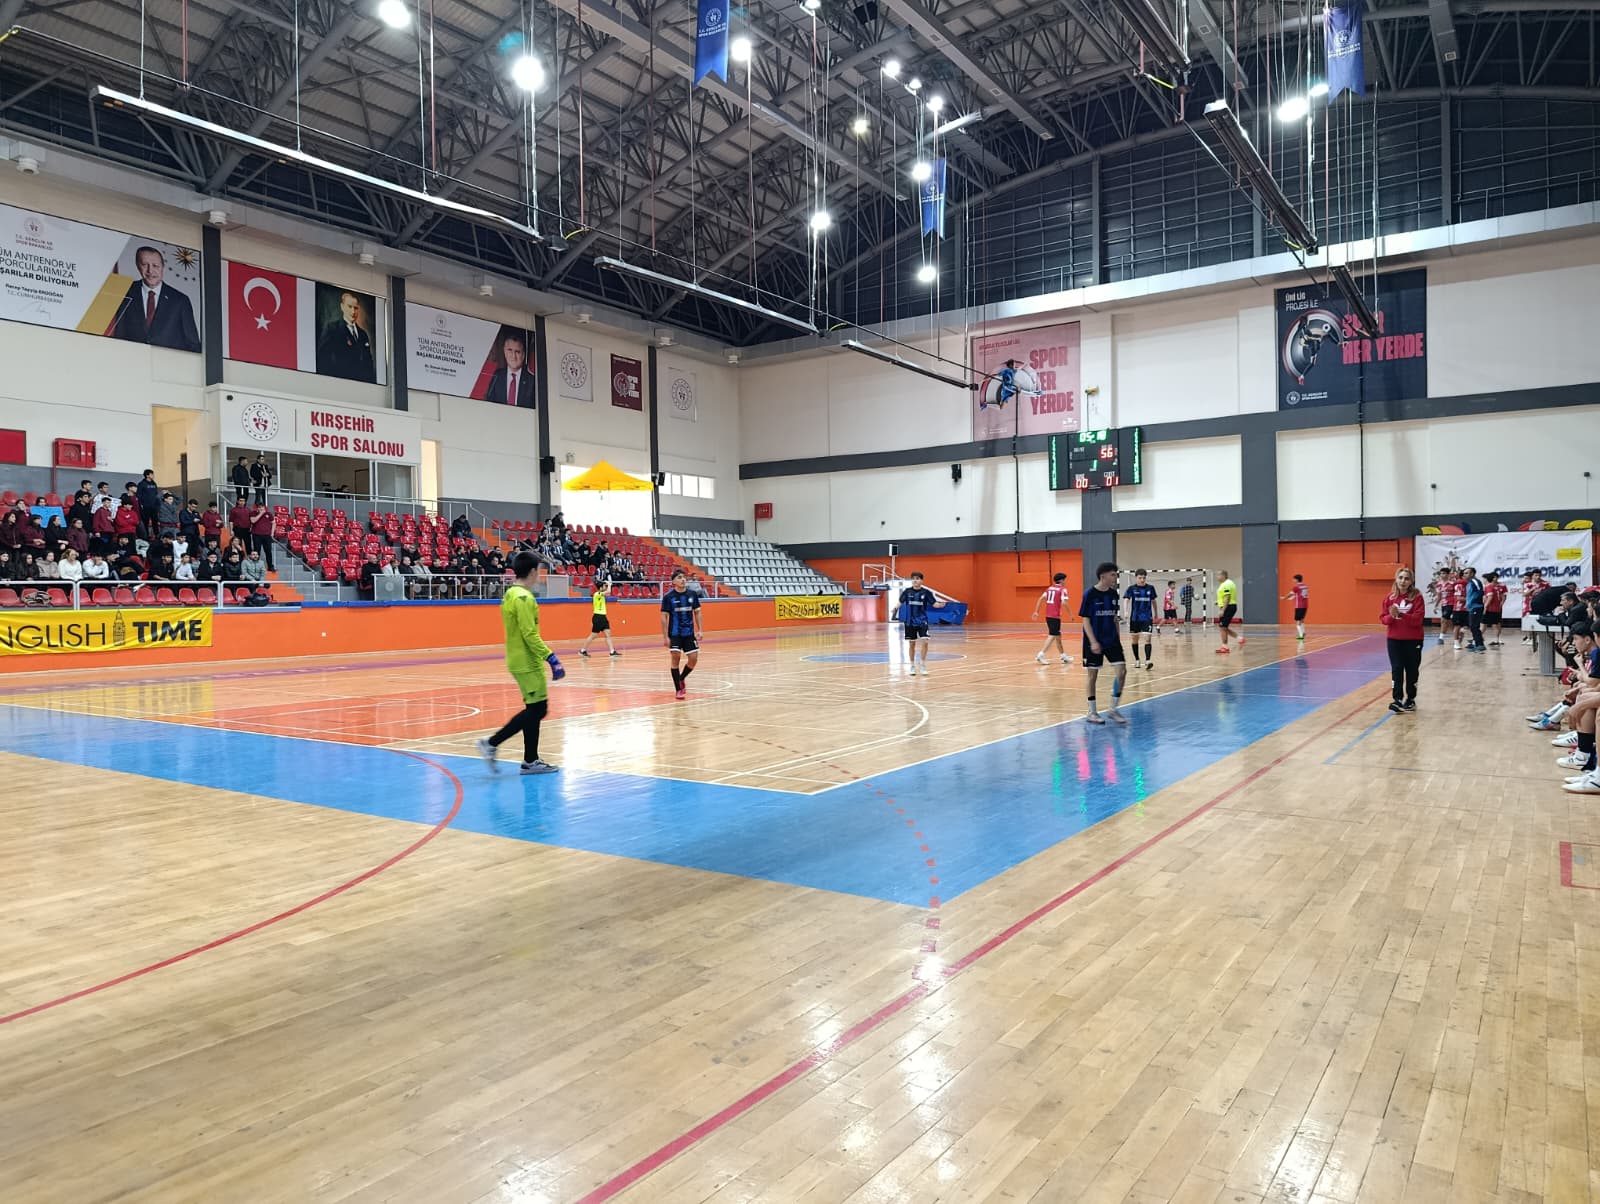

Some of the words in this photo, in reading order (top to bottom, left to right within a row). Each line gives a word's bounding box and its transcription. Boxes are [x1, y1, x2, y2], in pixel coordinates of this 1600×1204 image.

[66, 262, 77, 272] VE
[1029, 346, 1068, 370] SPOR
[1342, 339, 1372, 365] HER
[1375, 332, 1424, 361] YERDE
[1030, 391, 1074, 416] YERDE
[310, 411, 375, 432] KIRŞEHİR
[311, 432, 349, 452] SPOR
[353, 437, 404, 457] SALONU
[1101, 447, 1113, 459] 56
[779, 604, 815, 617] ENGLISH
[820, 603, 840, 614] TIME
[132, 619, 202, 643] TIME
